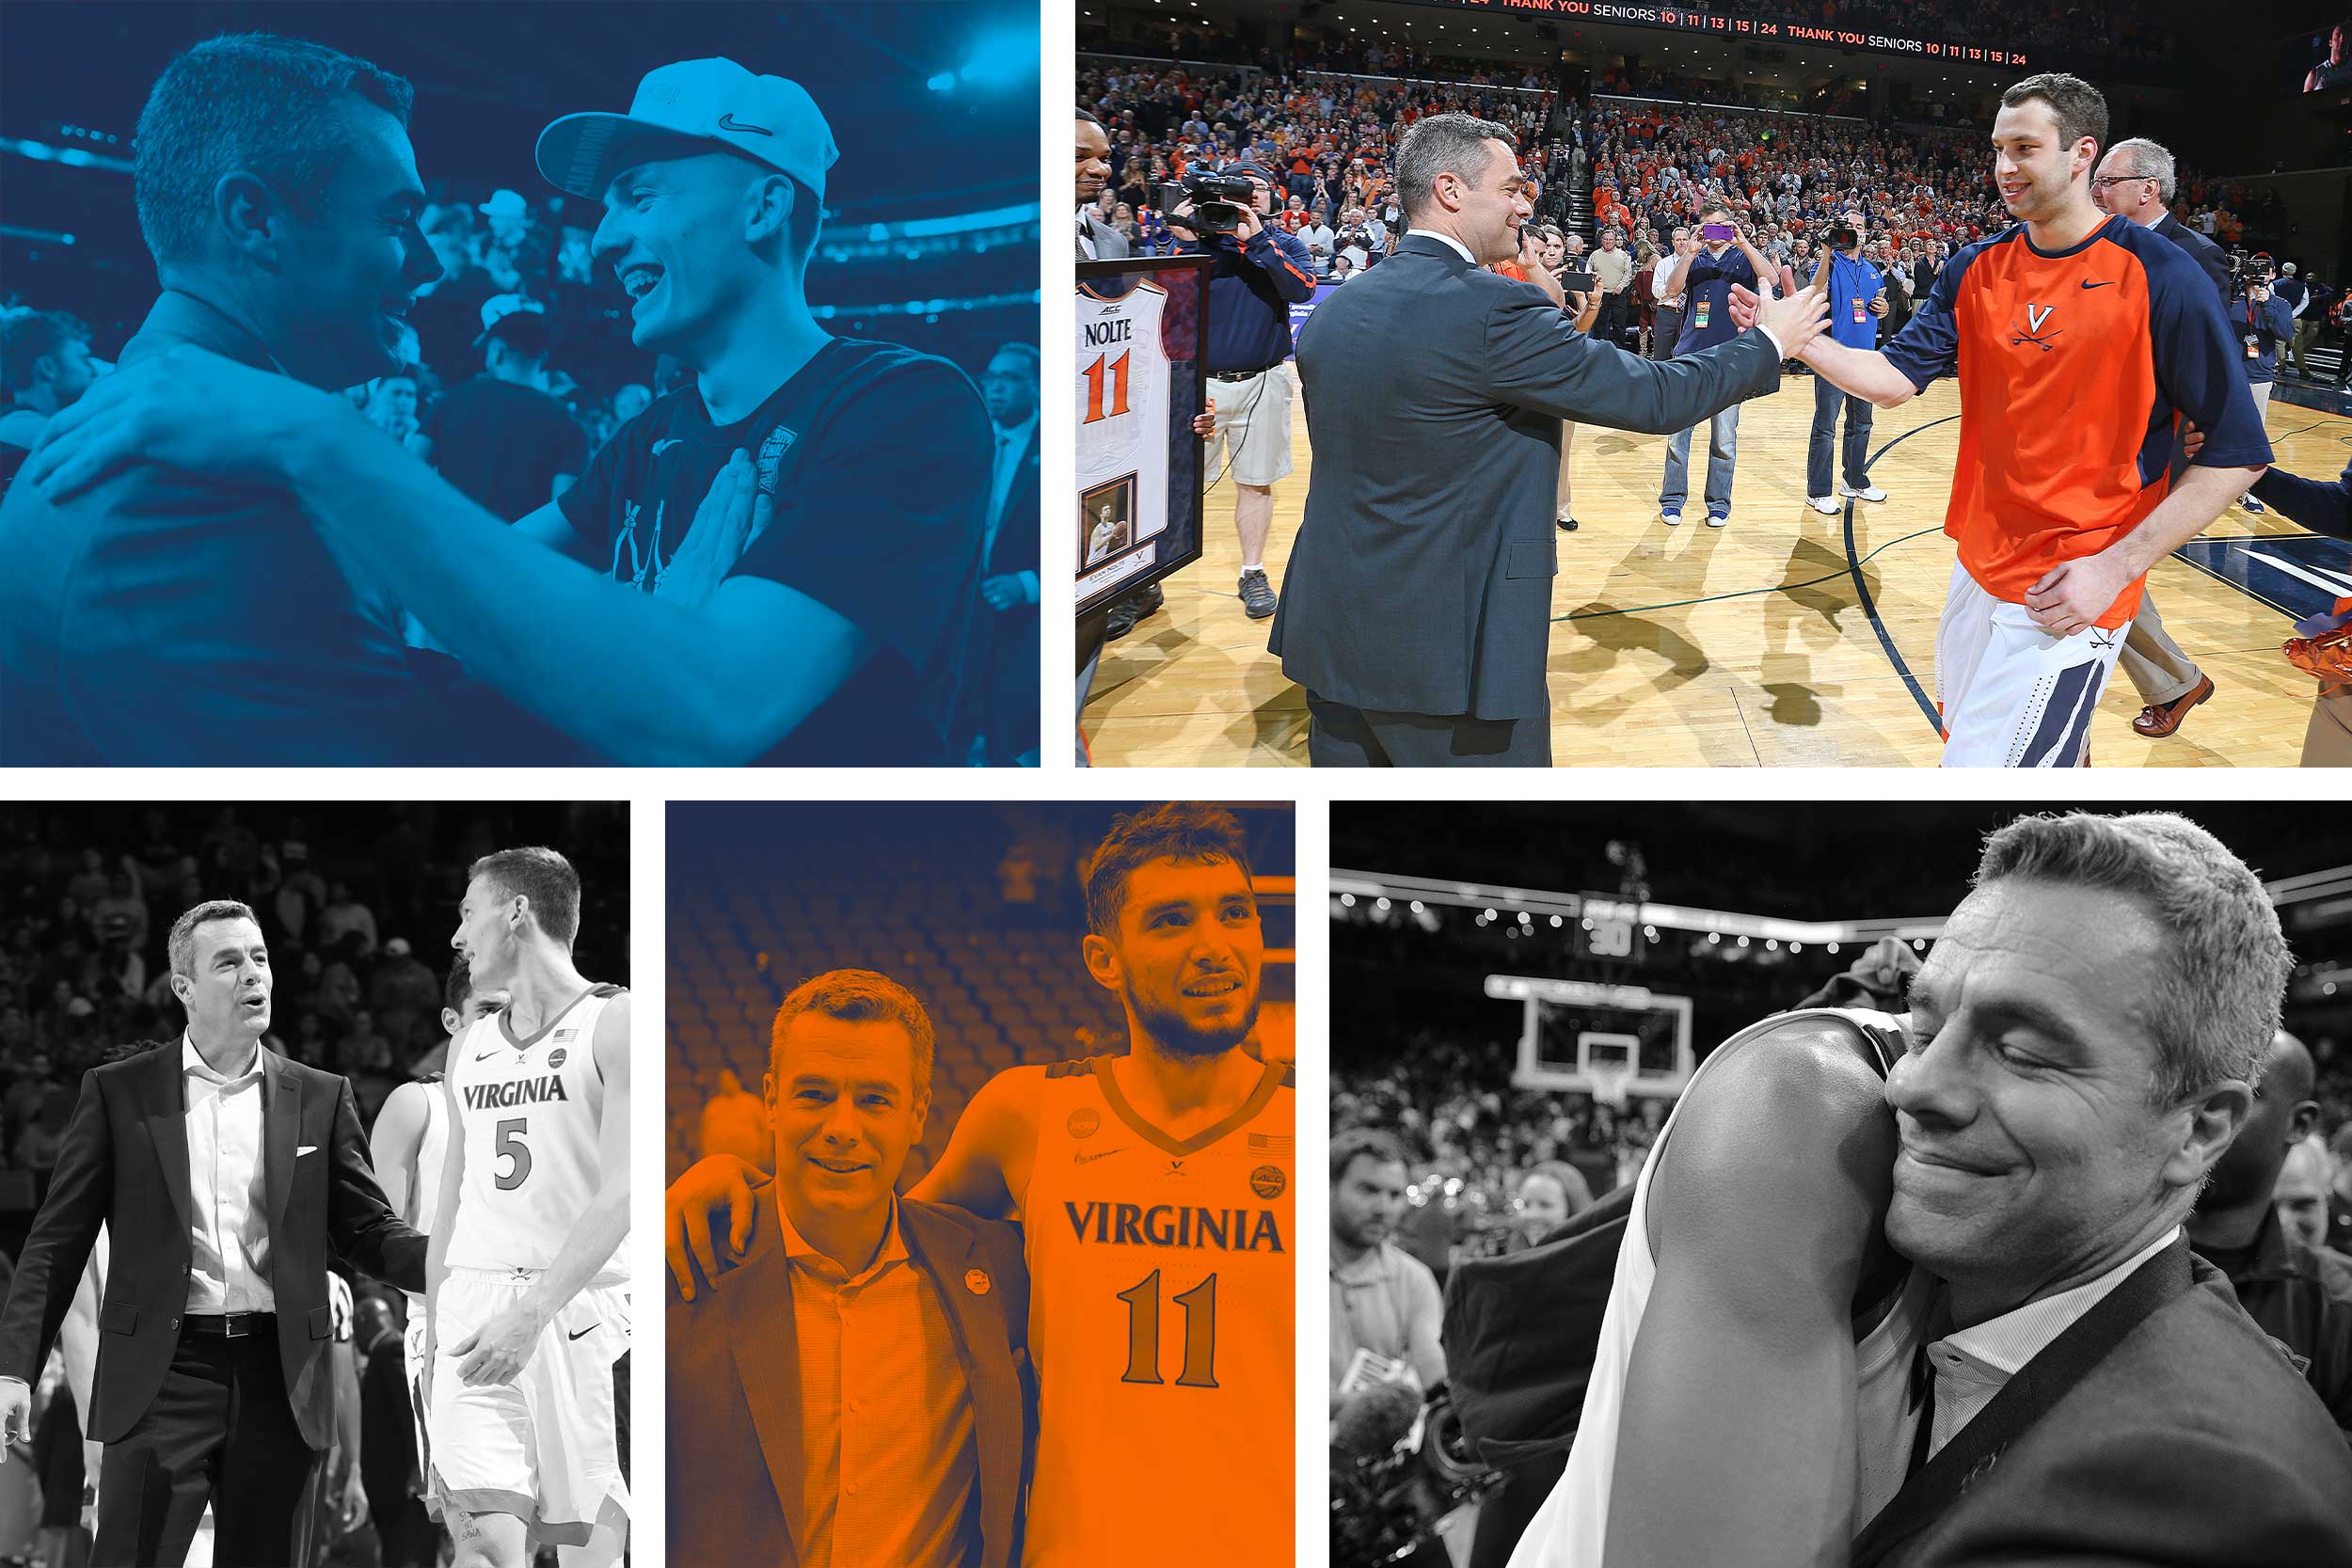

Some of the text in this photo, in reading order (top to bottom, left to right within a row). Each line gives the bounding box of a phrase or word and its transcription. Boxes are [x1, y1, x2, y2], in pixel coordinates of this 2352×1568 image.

[1558, 1, 1589, 14] YOU
[1593, 4, 1657, 22] SENIORS
[1661, 11, 1676, 24] 10
[1688, 14, 1699, 26] 11
[1710, 17, 1724, 29] 13
[1736, 20, 1750, 32] 15
[1760, 23, 1778, 36] 24
[1788, 25, 2026, 65] THANK YOU SENIORS 10 11 13 15 24
[1099, 305, 1122, 314] ACC
[1085, 319, 1132, 347] NOLTE
[1082, 347, 1131, 424] 11
[463, 1075, 569, 1112] VIRGINIA
[494, 1117, 532, 1191] 5
[1063, 1201, 1286, 1254] VIRGINIA
[1116, 1268, 1219, 1388] 11
